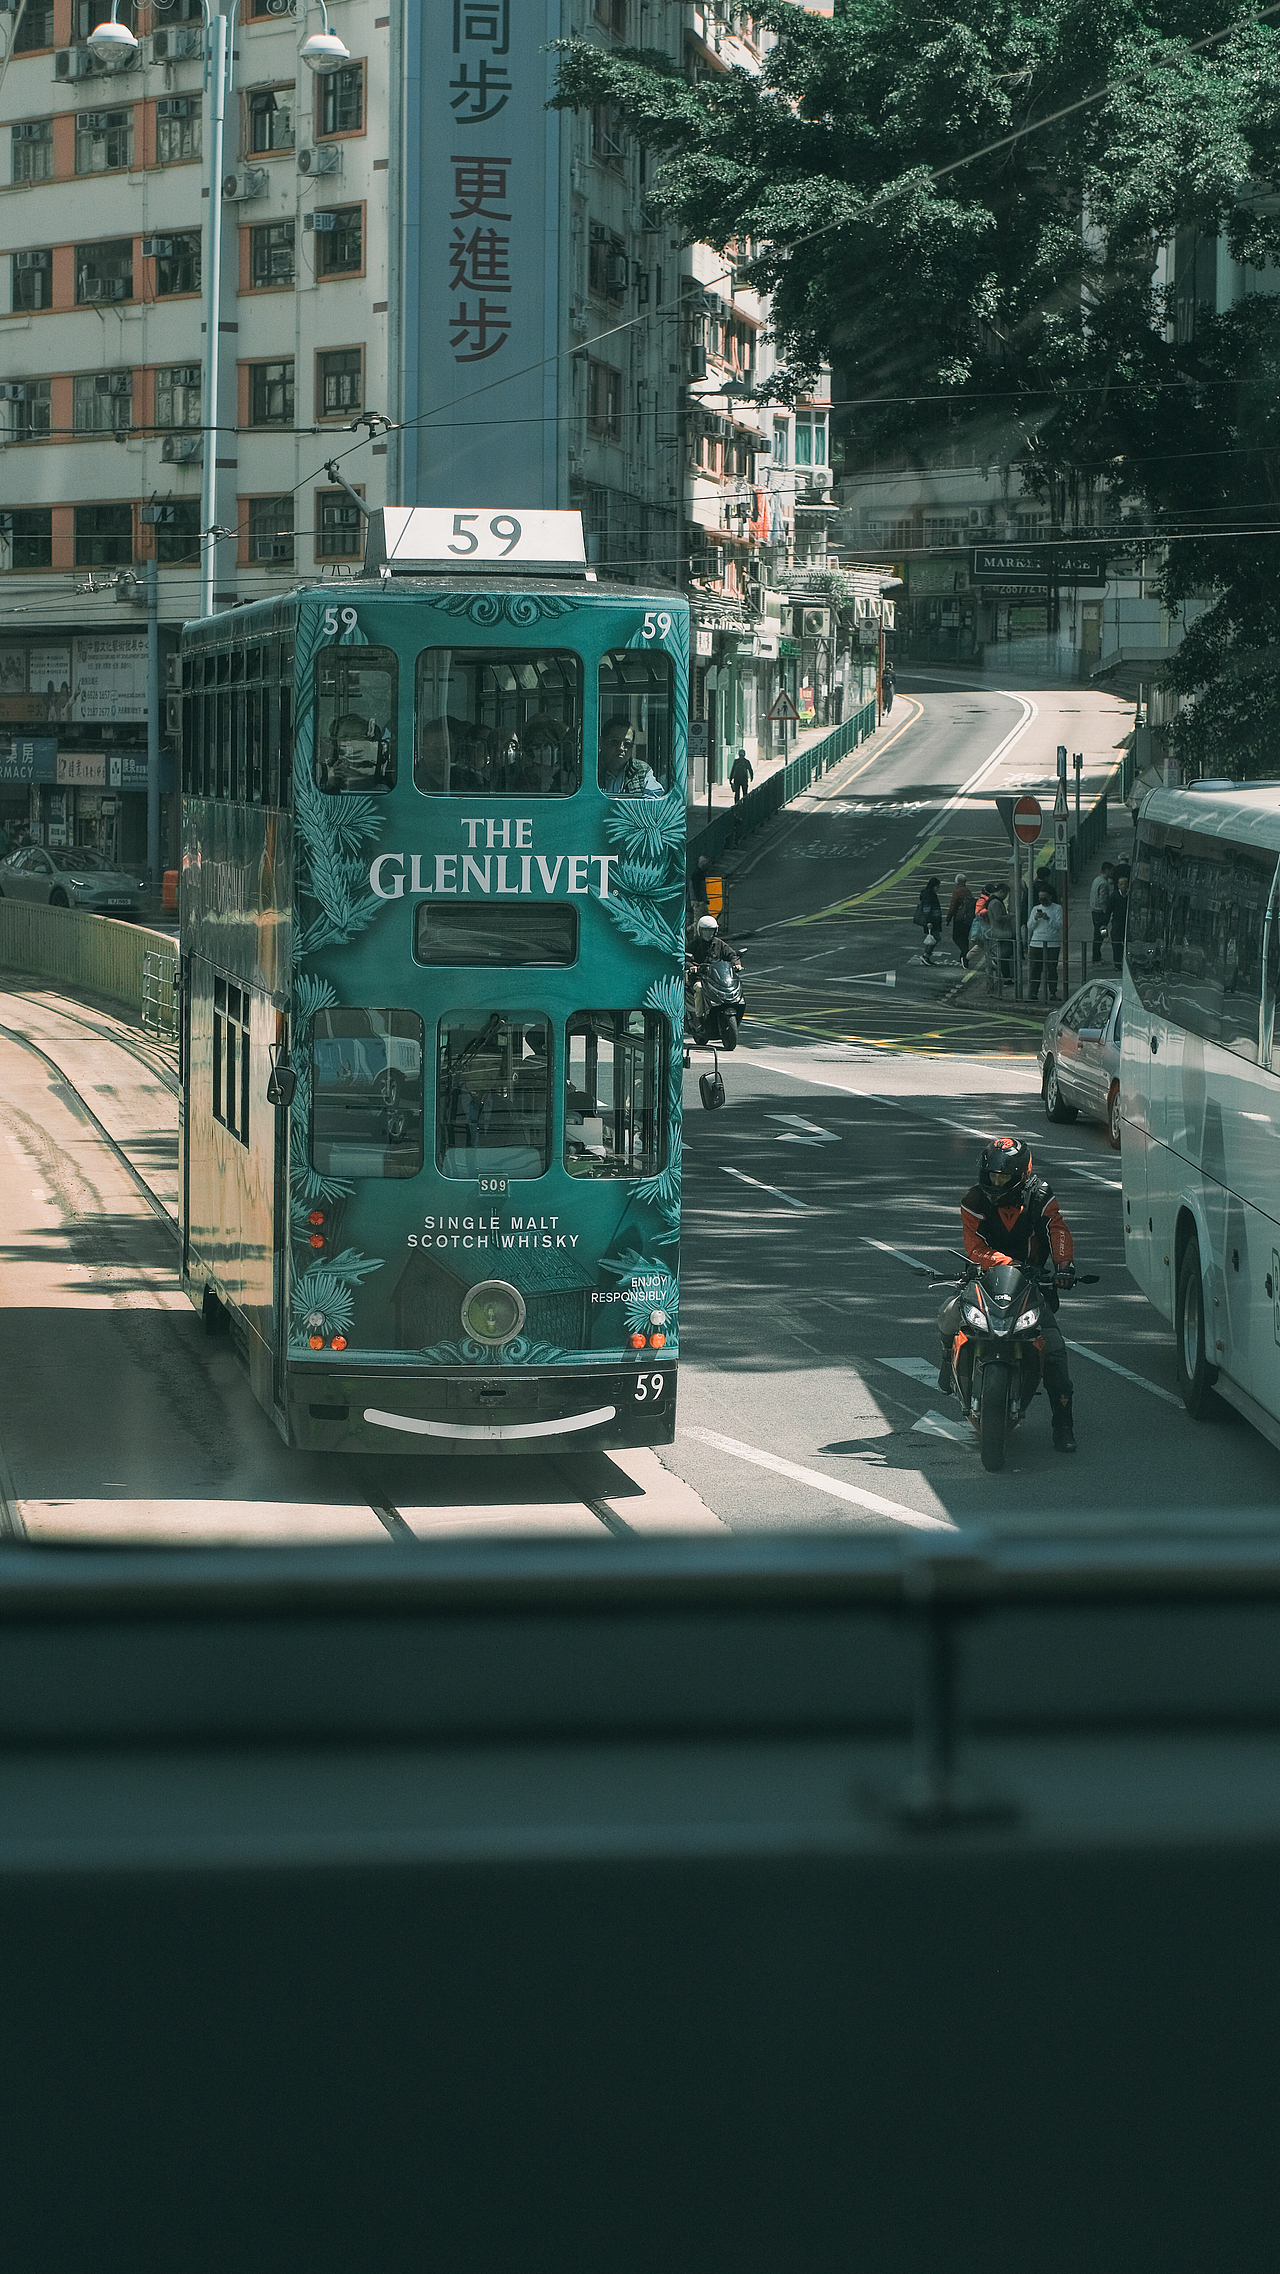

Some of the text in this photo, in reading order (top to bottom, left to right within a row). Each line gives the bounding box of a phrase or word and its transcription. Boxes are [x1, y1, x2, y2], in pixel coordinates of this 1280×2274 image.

[449, 0, 512, 364] 同步 更進步
[447, 515, 523, 557] 59
[322, 607, 359, 636] 59
[641, 612, 672, 640] 59
[835, 800, 933, 809] SLOW
[461, 818, 533, 849] THE
[370, 853, 619, 899] GLENLIVET
[424, 1216, 559, 1230] SINGLE MALT
[407, 1234, 580, 1248] SCOTCH WHISKY
[631, 1276, 669, 1288] ENJOY
[591, 1290, 668, 1303] RESPONSIBLY
[633, 1373, 665, 1401] 59
